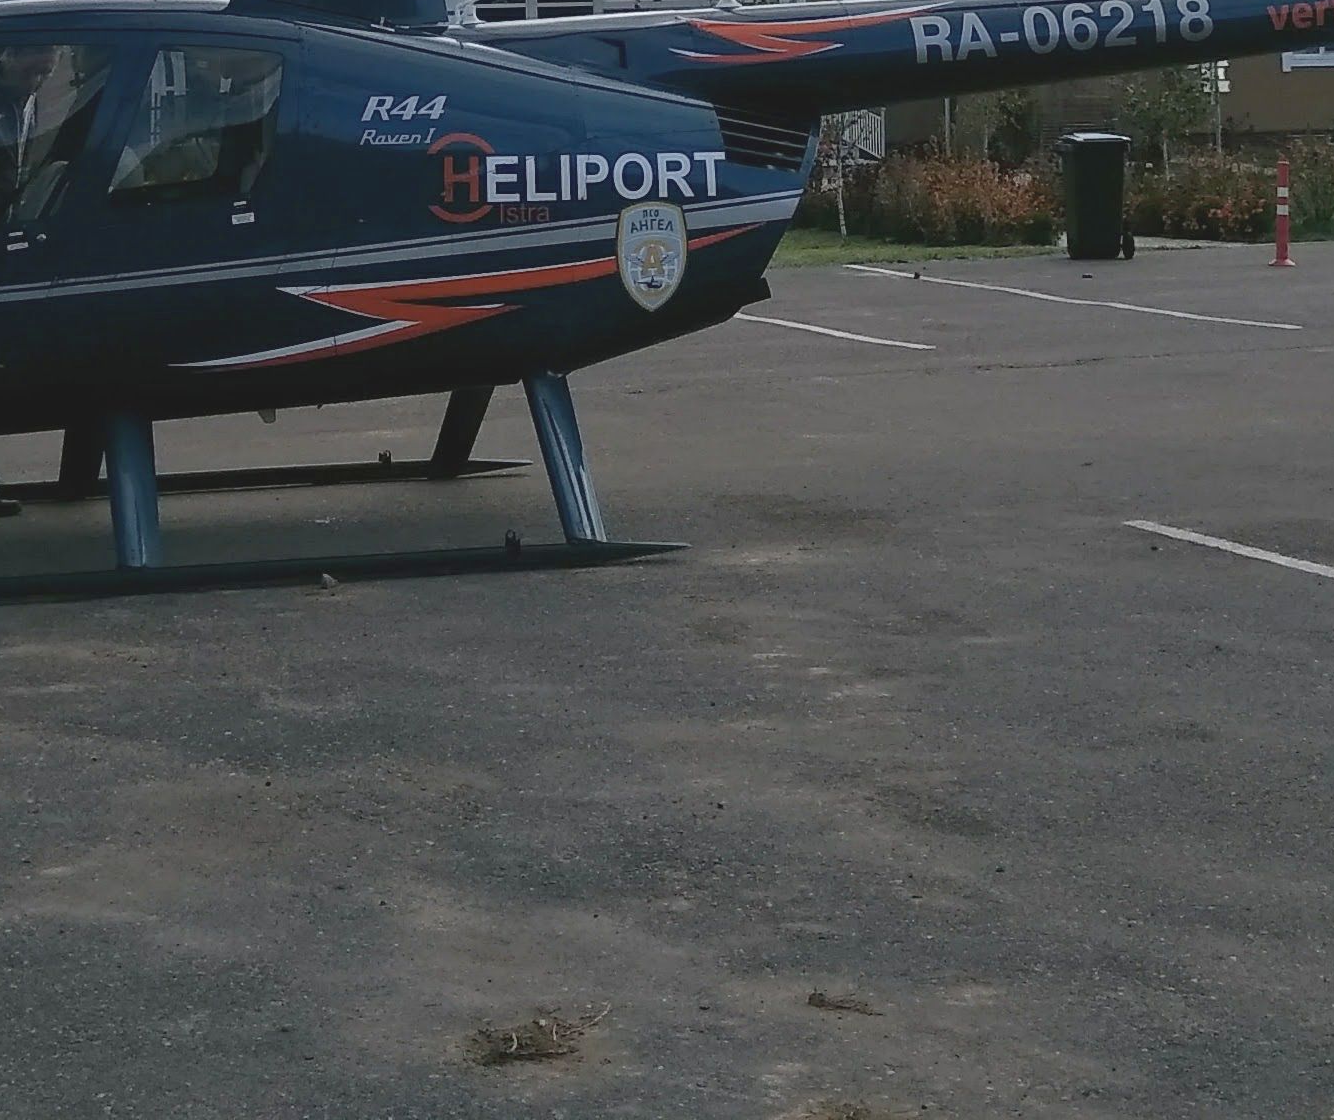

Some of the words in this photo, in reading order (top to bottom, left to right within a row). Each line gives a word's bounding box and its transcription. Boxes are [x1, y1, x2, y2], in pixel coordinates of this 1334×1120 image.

[361, 95, 447, 122] R44
[359, 129, 422, 146] Raven
[499, 203, 550, 225] Istra
[630, 219, 674, 234] АНГЕЛ
